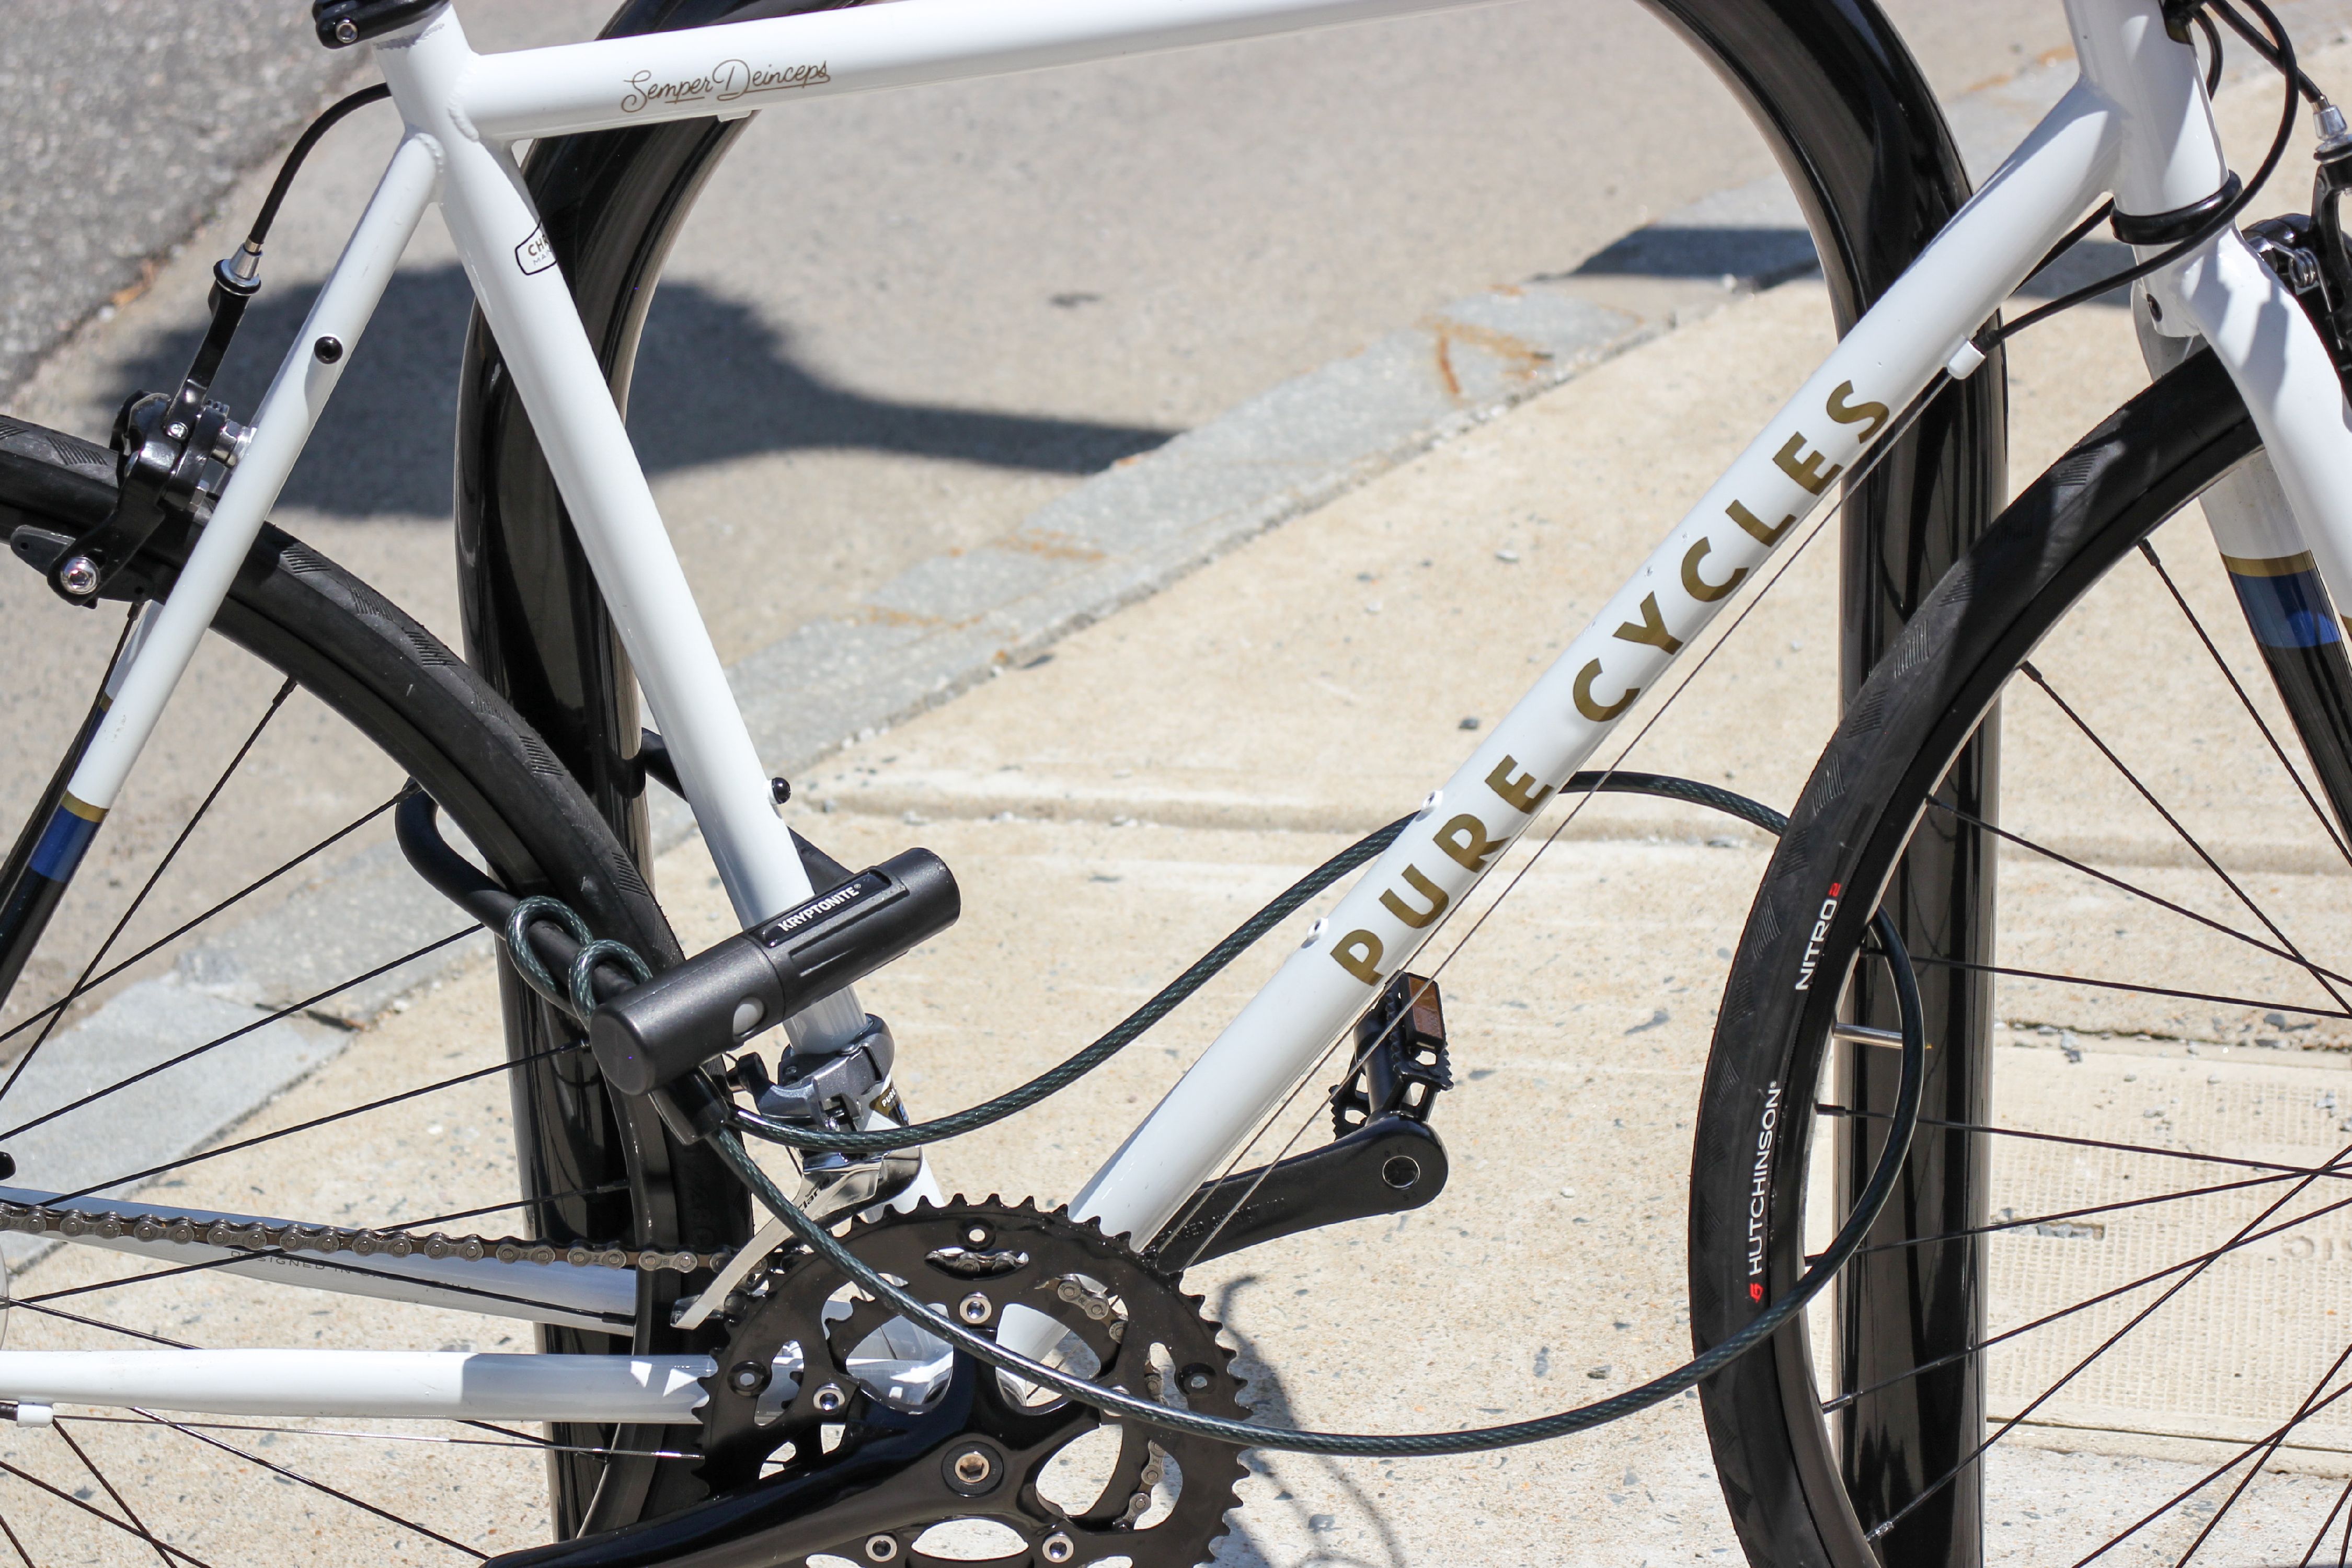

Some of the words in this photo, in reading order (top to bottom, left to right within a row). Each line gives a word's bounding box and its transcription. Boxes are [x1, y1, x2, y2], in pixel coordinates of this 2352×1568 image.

[621, 70, 713, 113] Semper
[712, 59, 831, 101] Deinceps
[1330, 754, 1554, 987] PURE
[1573, 379, 1890, 722] CYCLES
[1795, 900, 1838, 990] NITRO
